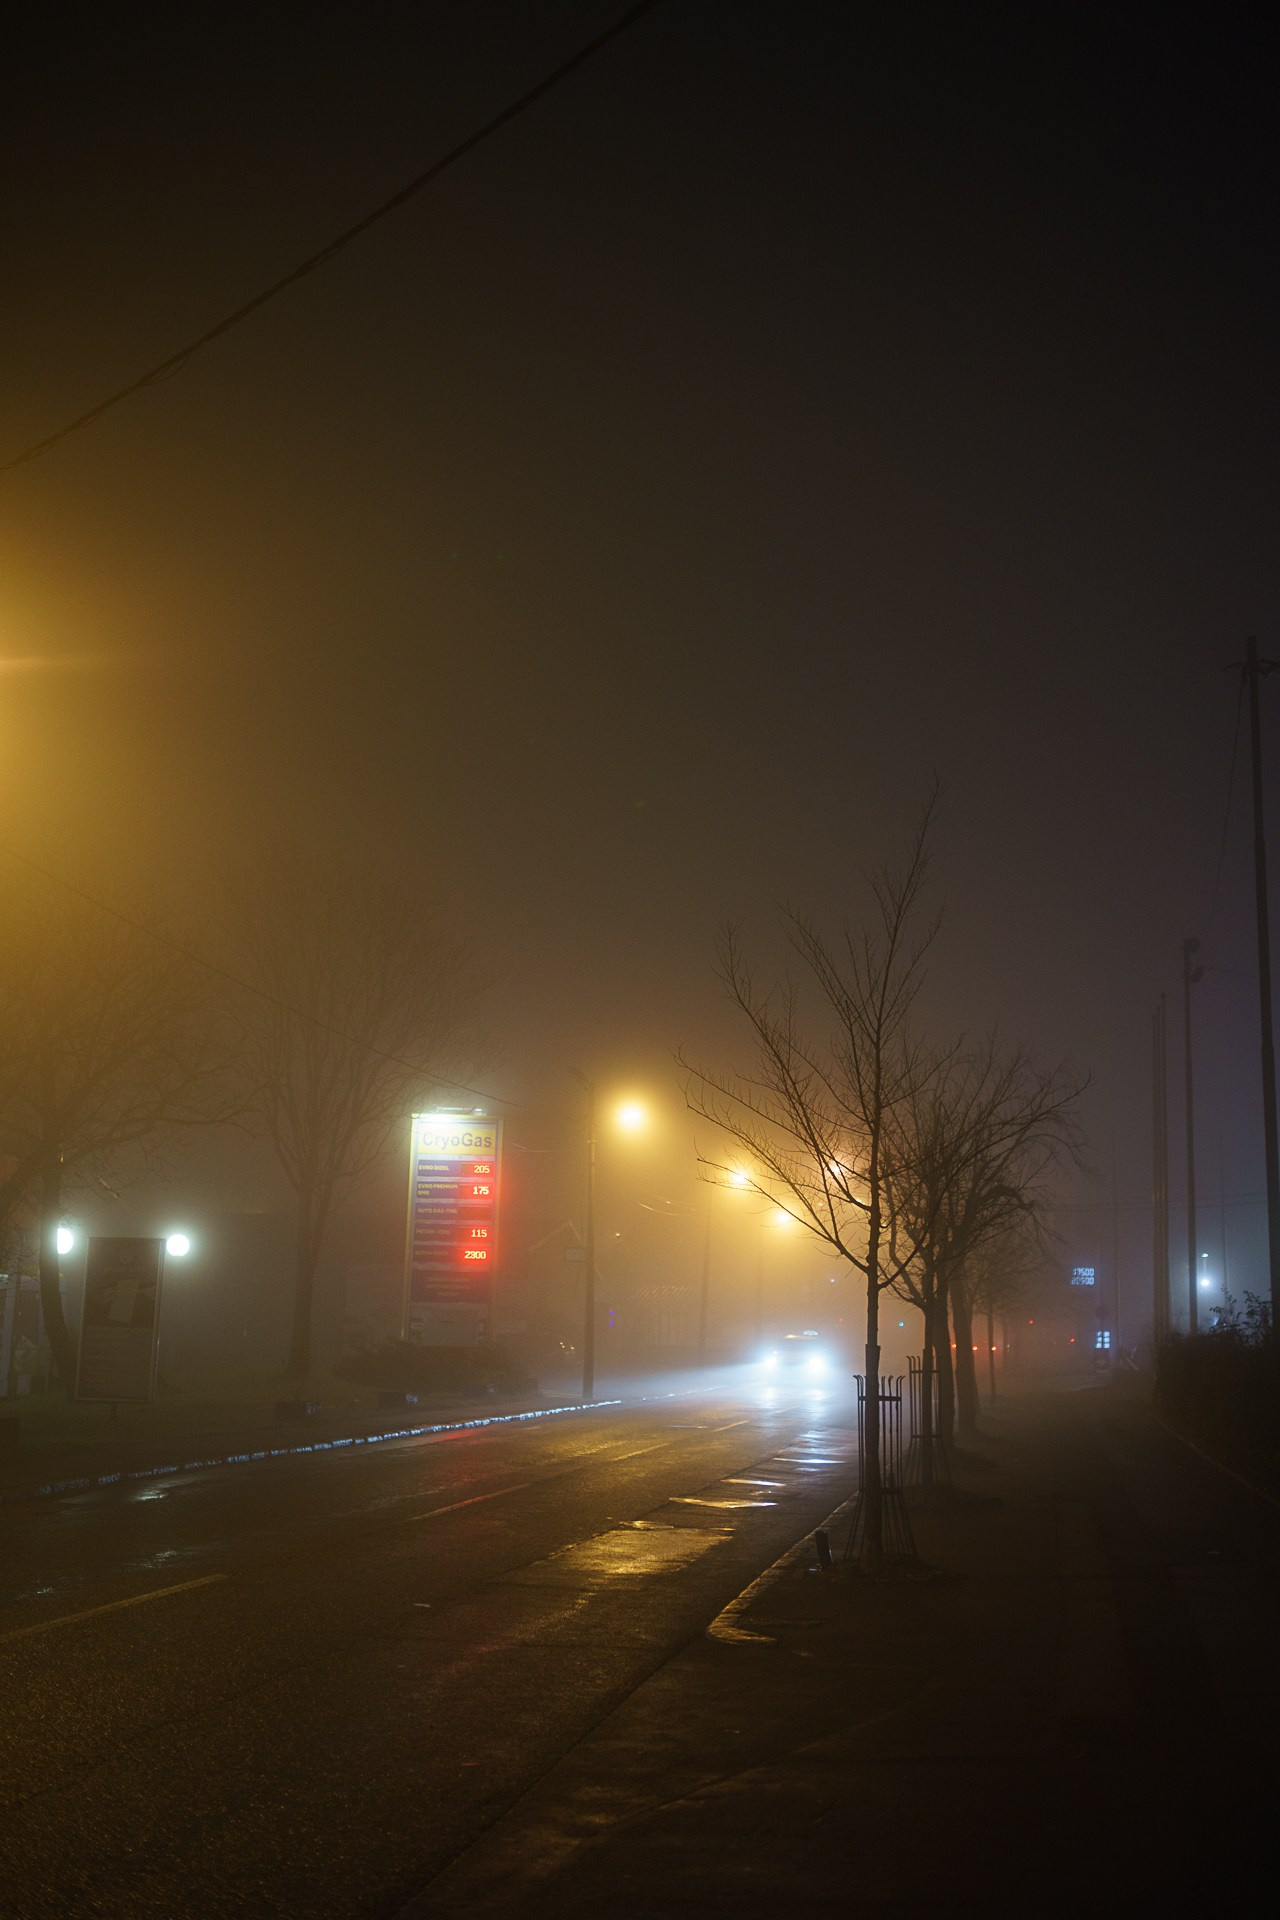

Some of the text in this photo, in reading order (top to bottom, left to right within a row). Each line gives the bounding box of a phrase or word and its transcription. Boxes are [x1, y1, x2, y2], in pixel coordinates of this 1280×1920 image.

[423, 1132, 492, 1150] CryoGas
[473, 1165, 490, 1174] 205
[472, 1186, 489, 1195] 175
[471, 1229, 488, 1238] 115
[464, 1250, 487, 1259] 2300
